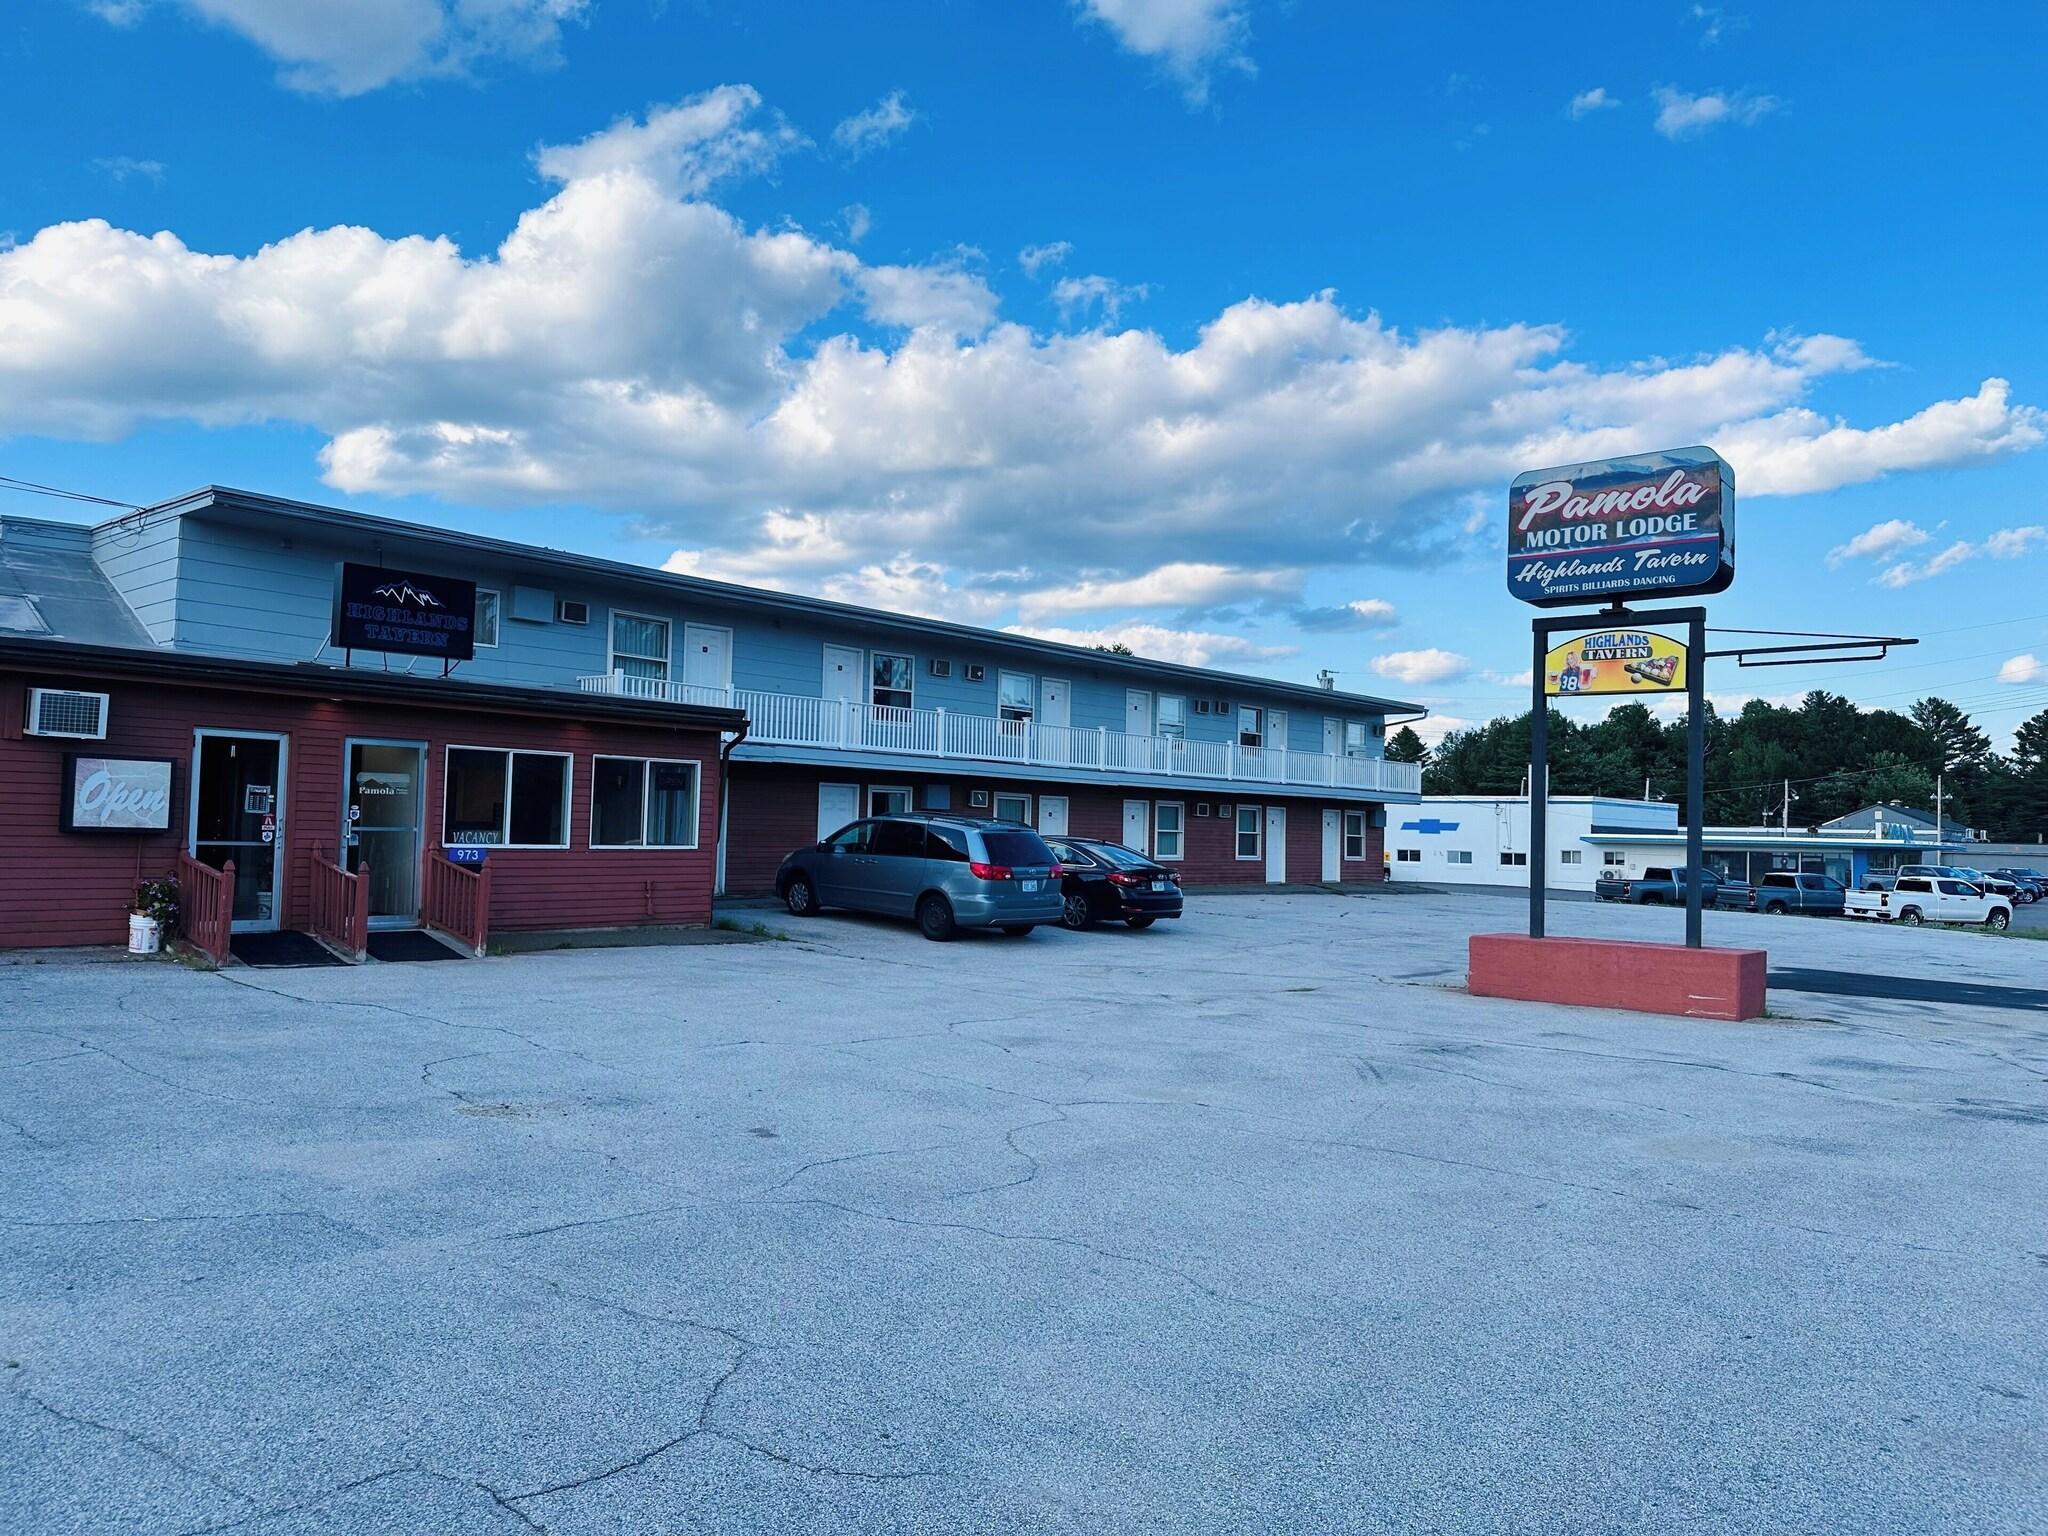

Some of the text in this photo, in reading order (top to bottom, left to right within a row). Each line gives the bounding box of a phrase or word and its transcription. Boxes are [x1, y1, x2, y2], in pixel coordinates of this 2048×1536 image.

[1518, 469, 1710, 531] Pamola
[1526, 512, 1699, 548] MOTOR LODGE
[1515, 549, 1710, 588] Highlands Tavern
[1543, 574, 1676, 595] SPIRITS BILLIARDS DANCING
[346, 602, 469, 632] HIGHLANDS
[364, 623, 449, 647] TAVERN
[1584, 634, 1650, 649] HIGHLANDS
[1586, 647, 1649, 660] TAVERN
[1561, 675, 1578, 691] 38
[79, 770, 166, 823] Open
[359, 786, 395, 795] Pamola
[453, 831, 499, 844] VACANCY
[457, 849, 479, 861] 973
